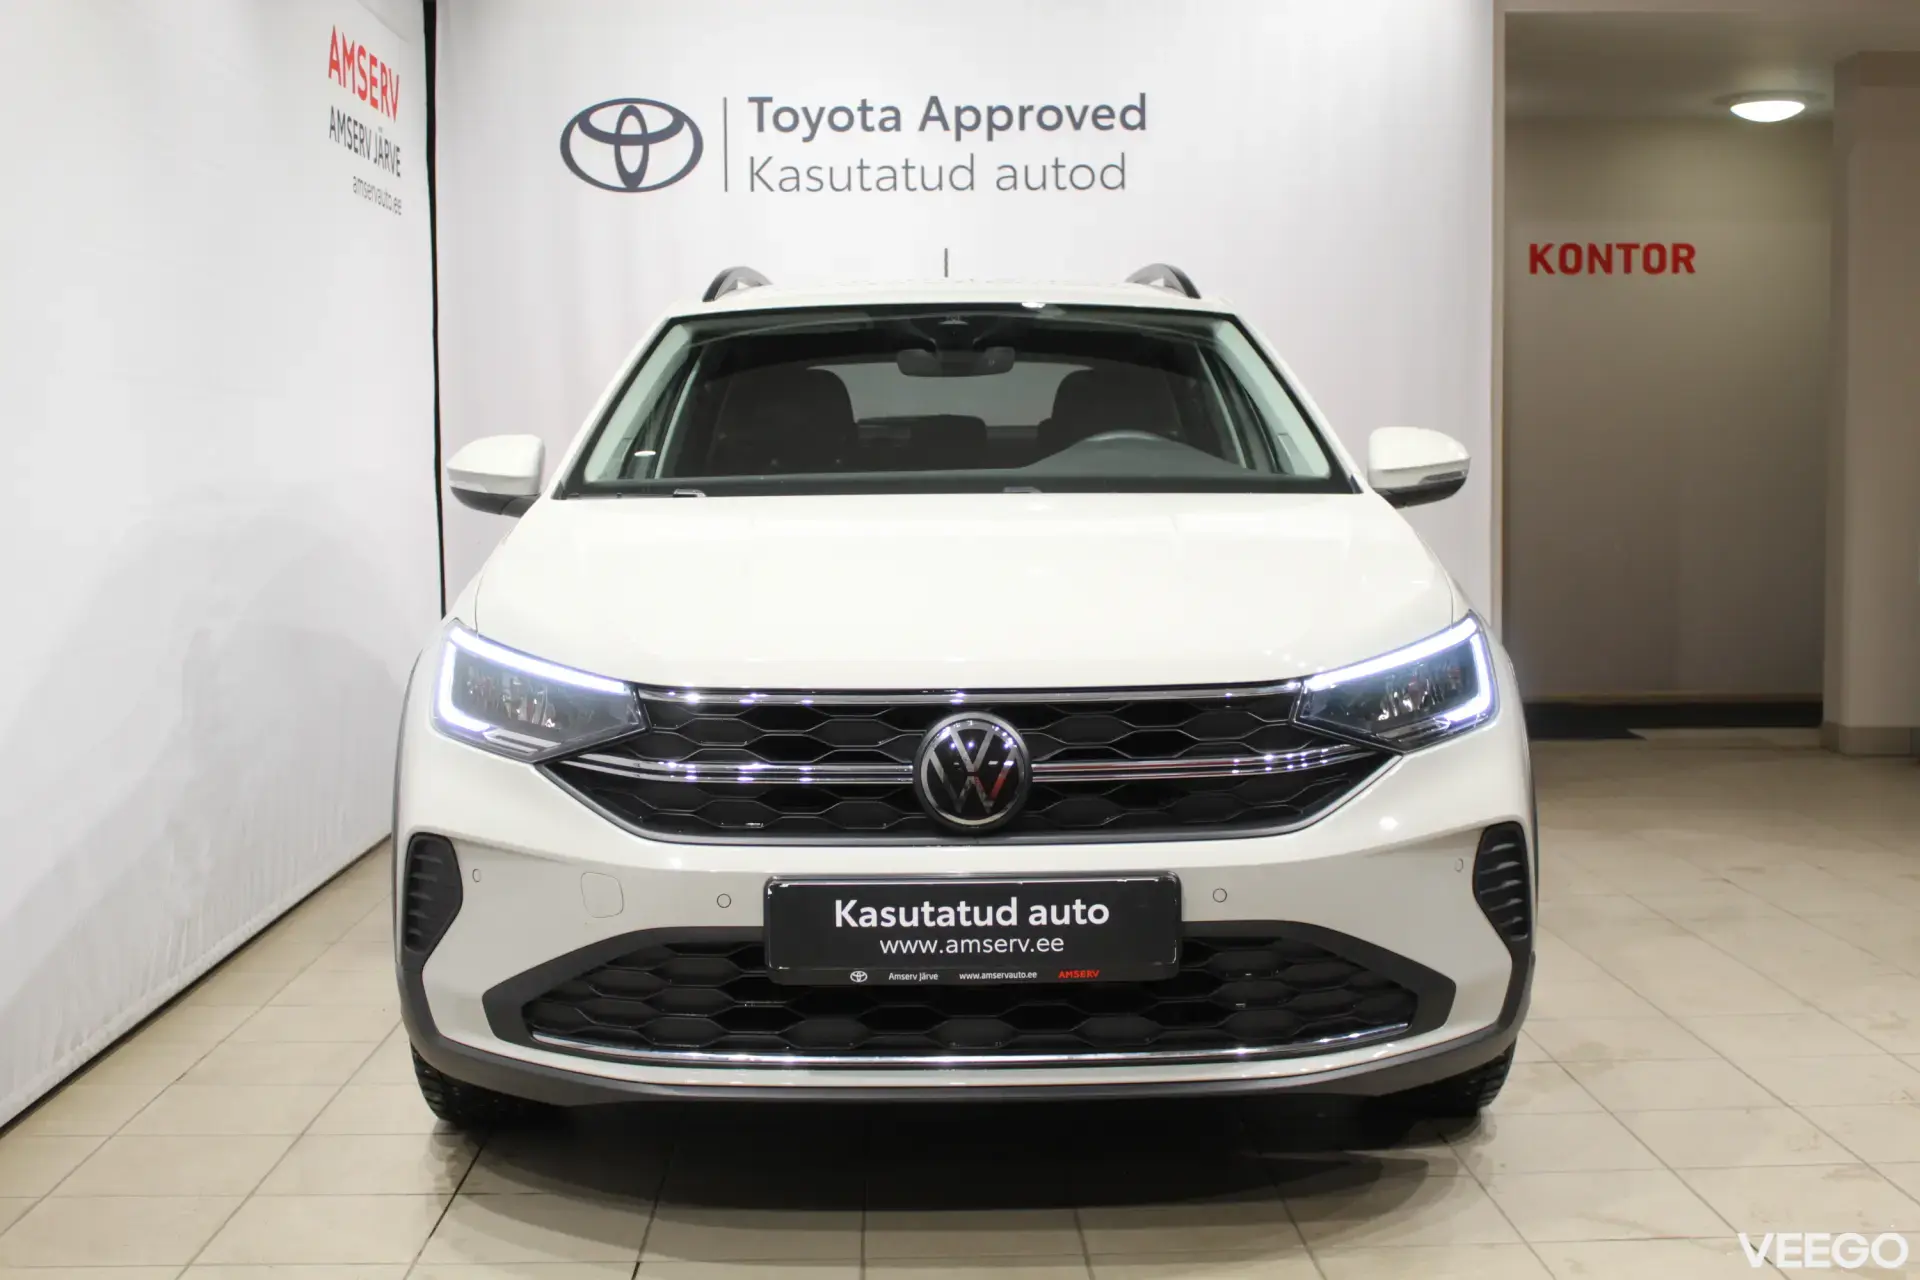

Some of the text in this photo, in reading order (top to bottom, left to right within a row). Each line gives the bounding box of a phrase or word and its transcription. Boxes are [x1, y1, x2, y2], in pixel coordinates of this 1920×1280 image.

[328, 24, 400, 123] AMSERV
[748, 92, 1148, 142] Toyota Approved
[329, 105, 401, 178] AMSERV JÄRVE
[748, 152, 1127, 193] Kasutatud autod
[352, 175, 402, 216] amservauto.ee
[1529, 242, 1696, 275] KONTOR
[834, 897, 1110, 928] Kasutatud auto
[879, 935, 1065, 955] www.amserv.ee
[888, 971, 938, 981] Amserv Järve
[958, 970, 1038, 981] www.amservauto.ee
[1058, 970, 1099, 980] AMSERV
